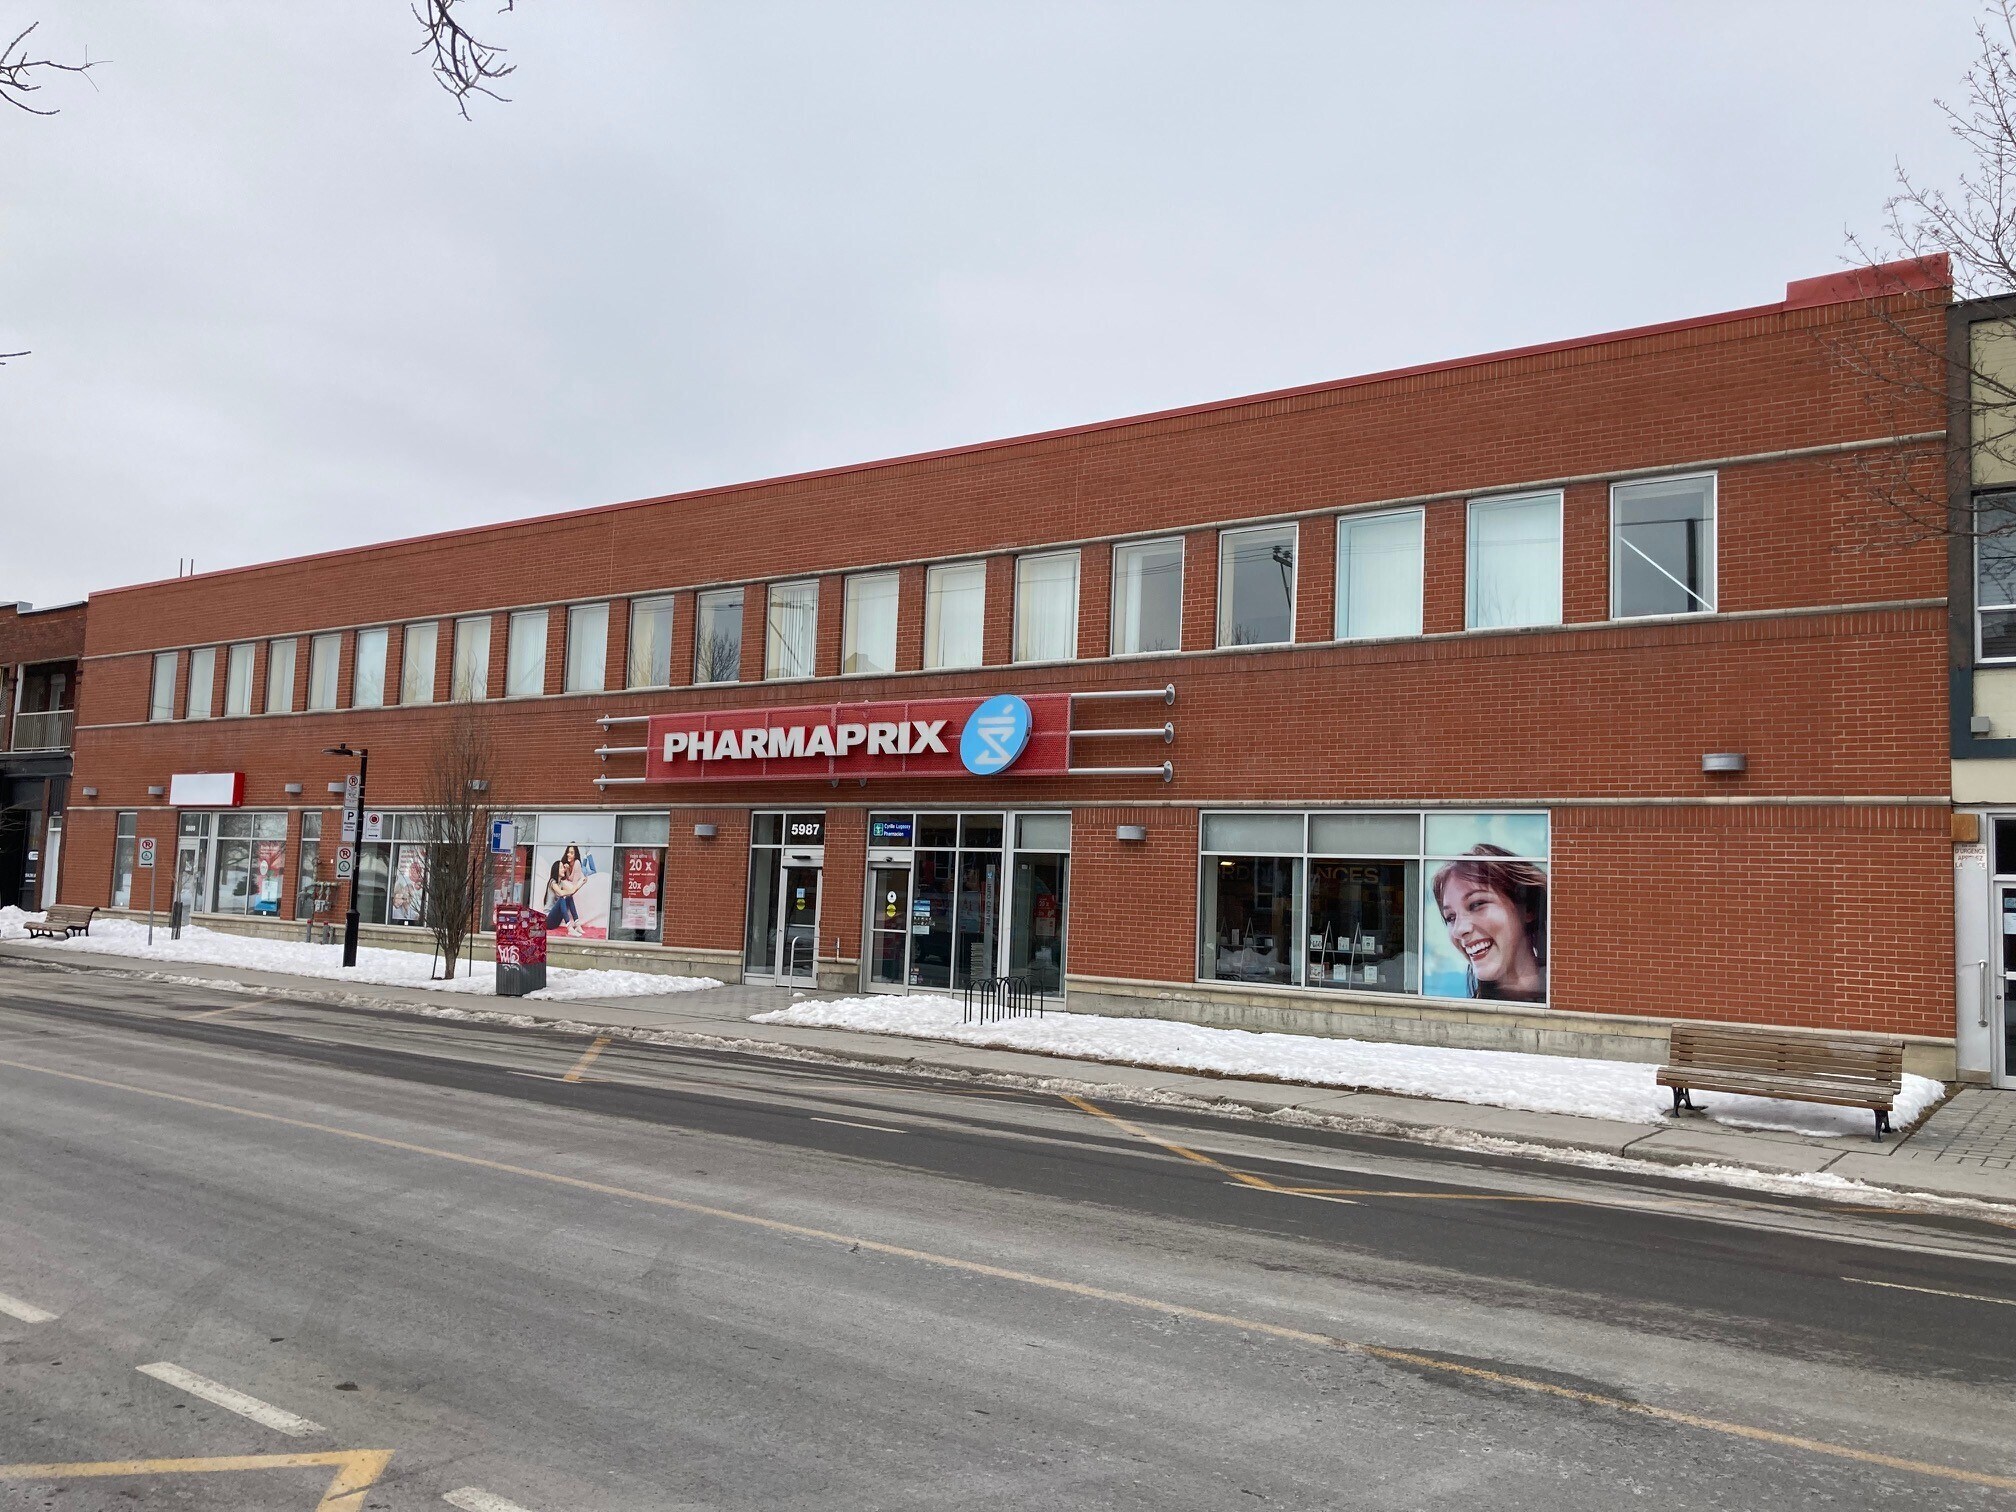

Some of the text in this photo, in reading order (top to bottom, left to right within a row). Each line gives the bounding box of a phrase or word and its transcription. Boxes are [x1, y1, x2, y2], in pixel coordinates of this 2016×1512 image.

[663, 719, 950, 763] PHARMAPRIX
[791, 823, 820, 836] 5987
[629, 858, 642, 871] 20
